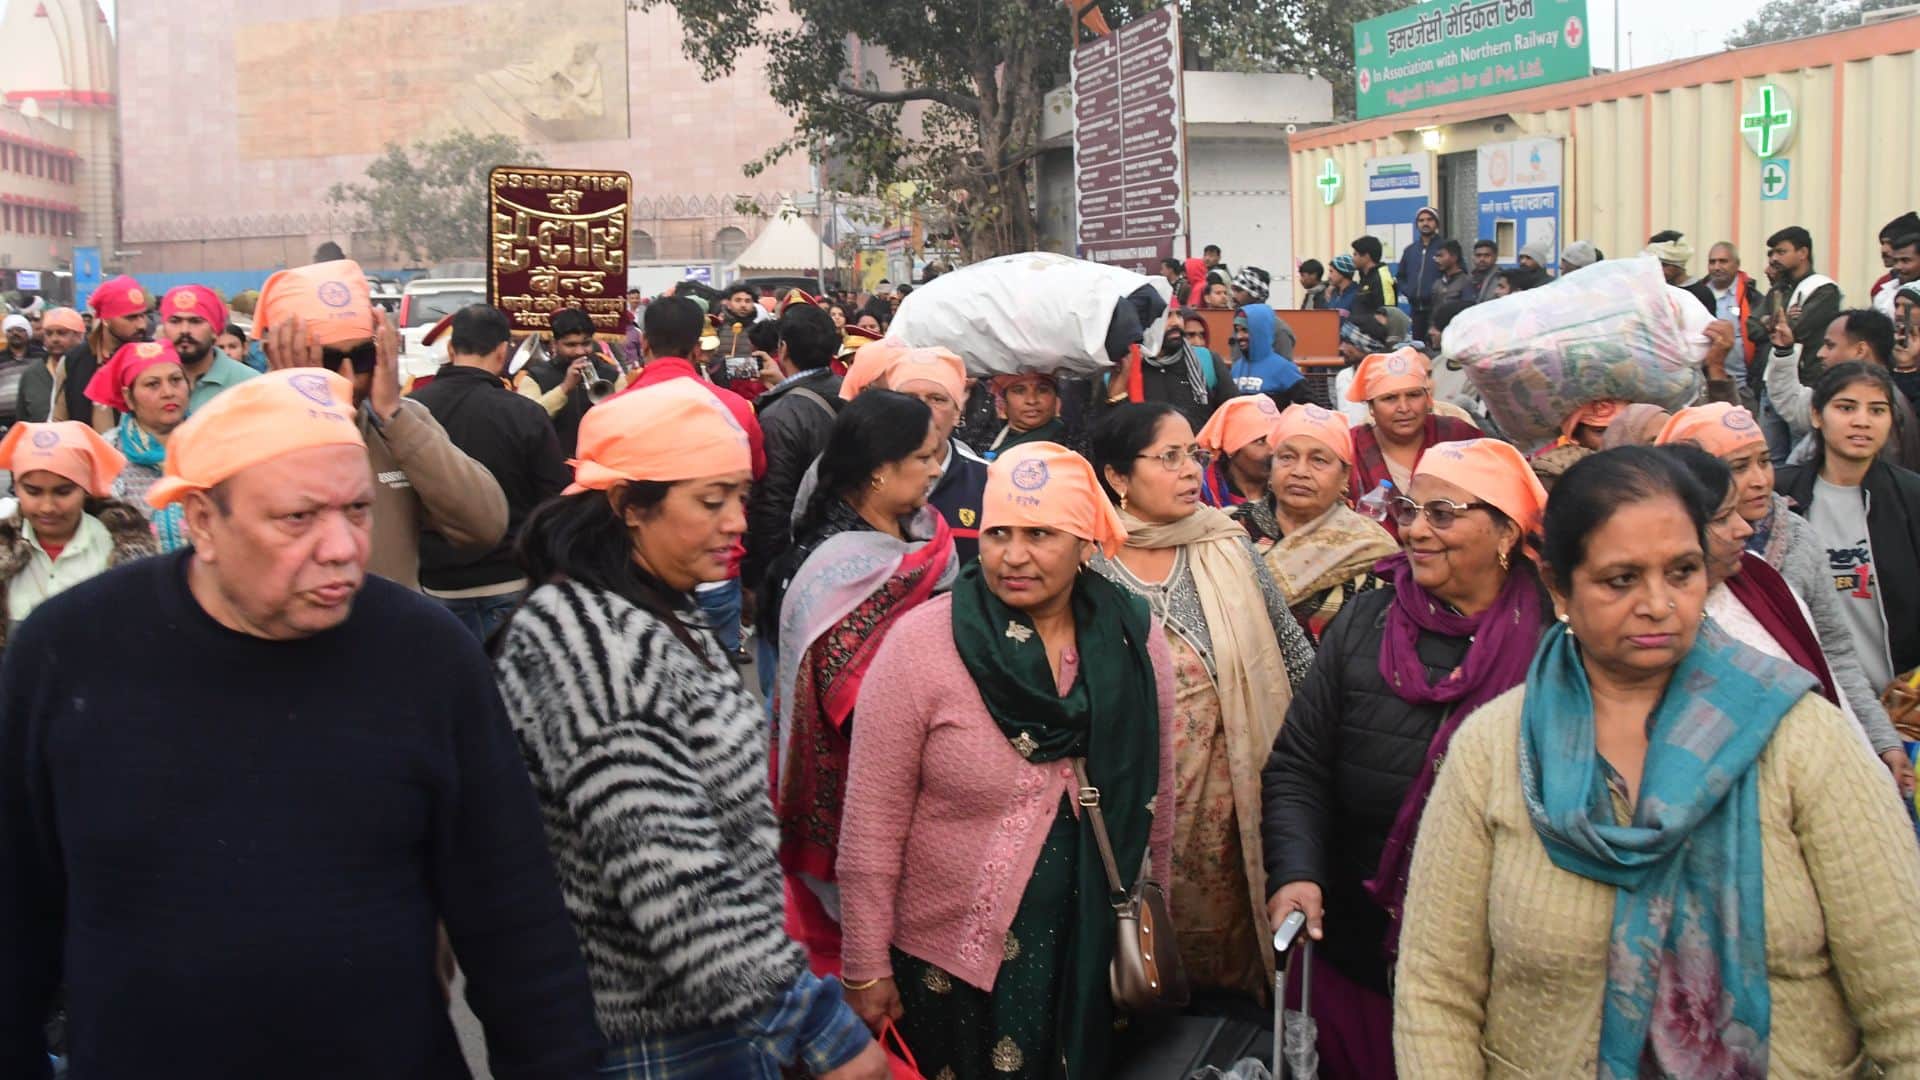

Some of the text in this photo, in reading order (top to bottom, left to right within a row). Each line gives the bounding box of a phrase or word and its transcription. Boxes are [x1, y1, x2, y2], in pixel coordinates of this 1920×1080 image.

[1387, 10, 1443, 55] इमरजेंसी
[1445, 1, 1500, 36] मेडिकल
[1383, 58, 1434, 81] Association
[1436, 52, 1459, 69] with
[1460, 40, 1512, 63] Northern
[1514, 30, 1559, 51] Railway
[1851, 563, 1873, 599] 1
